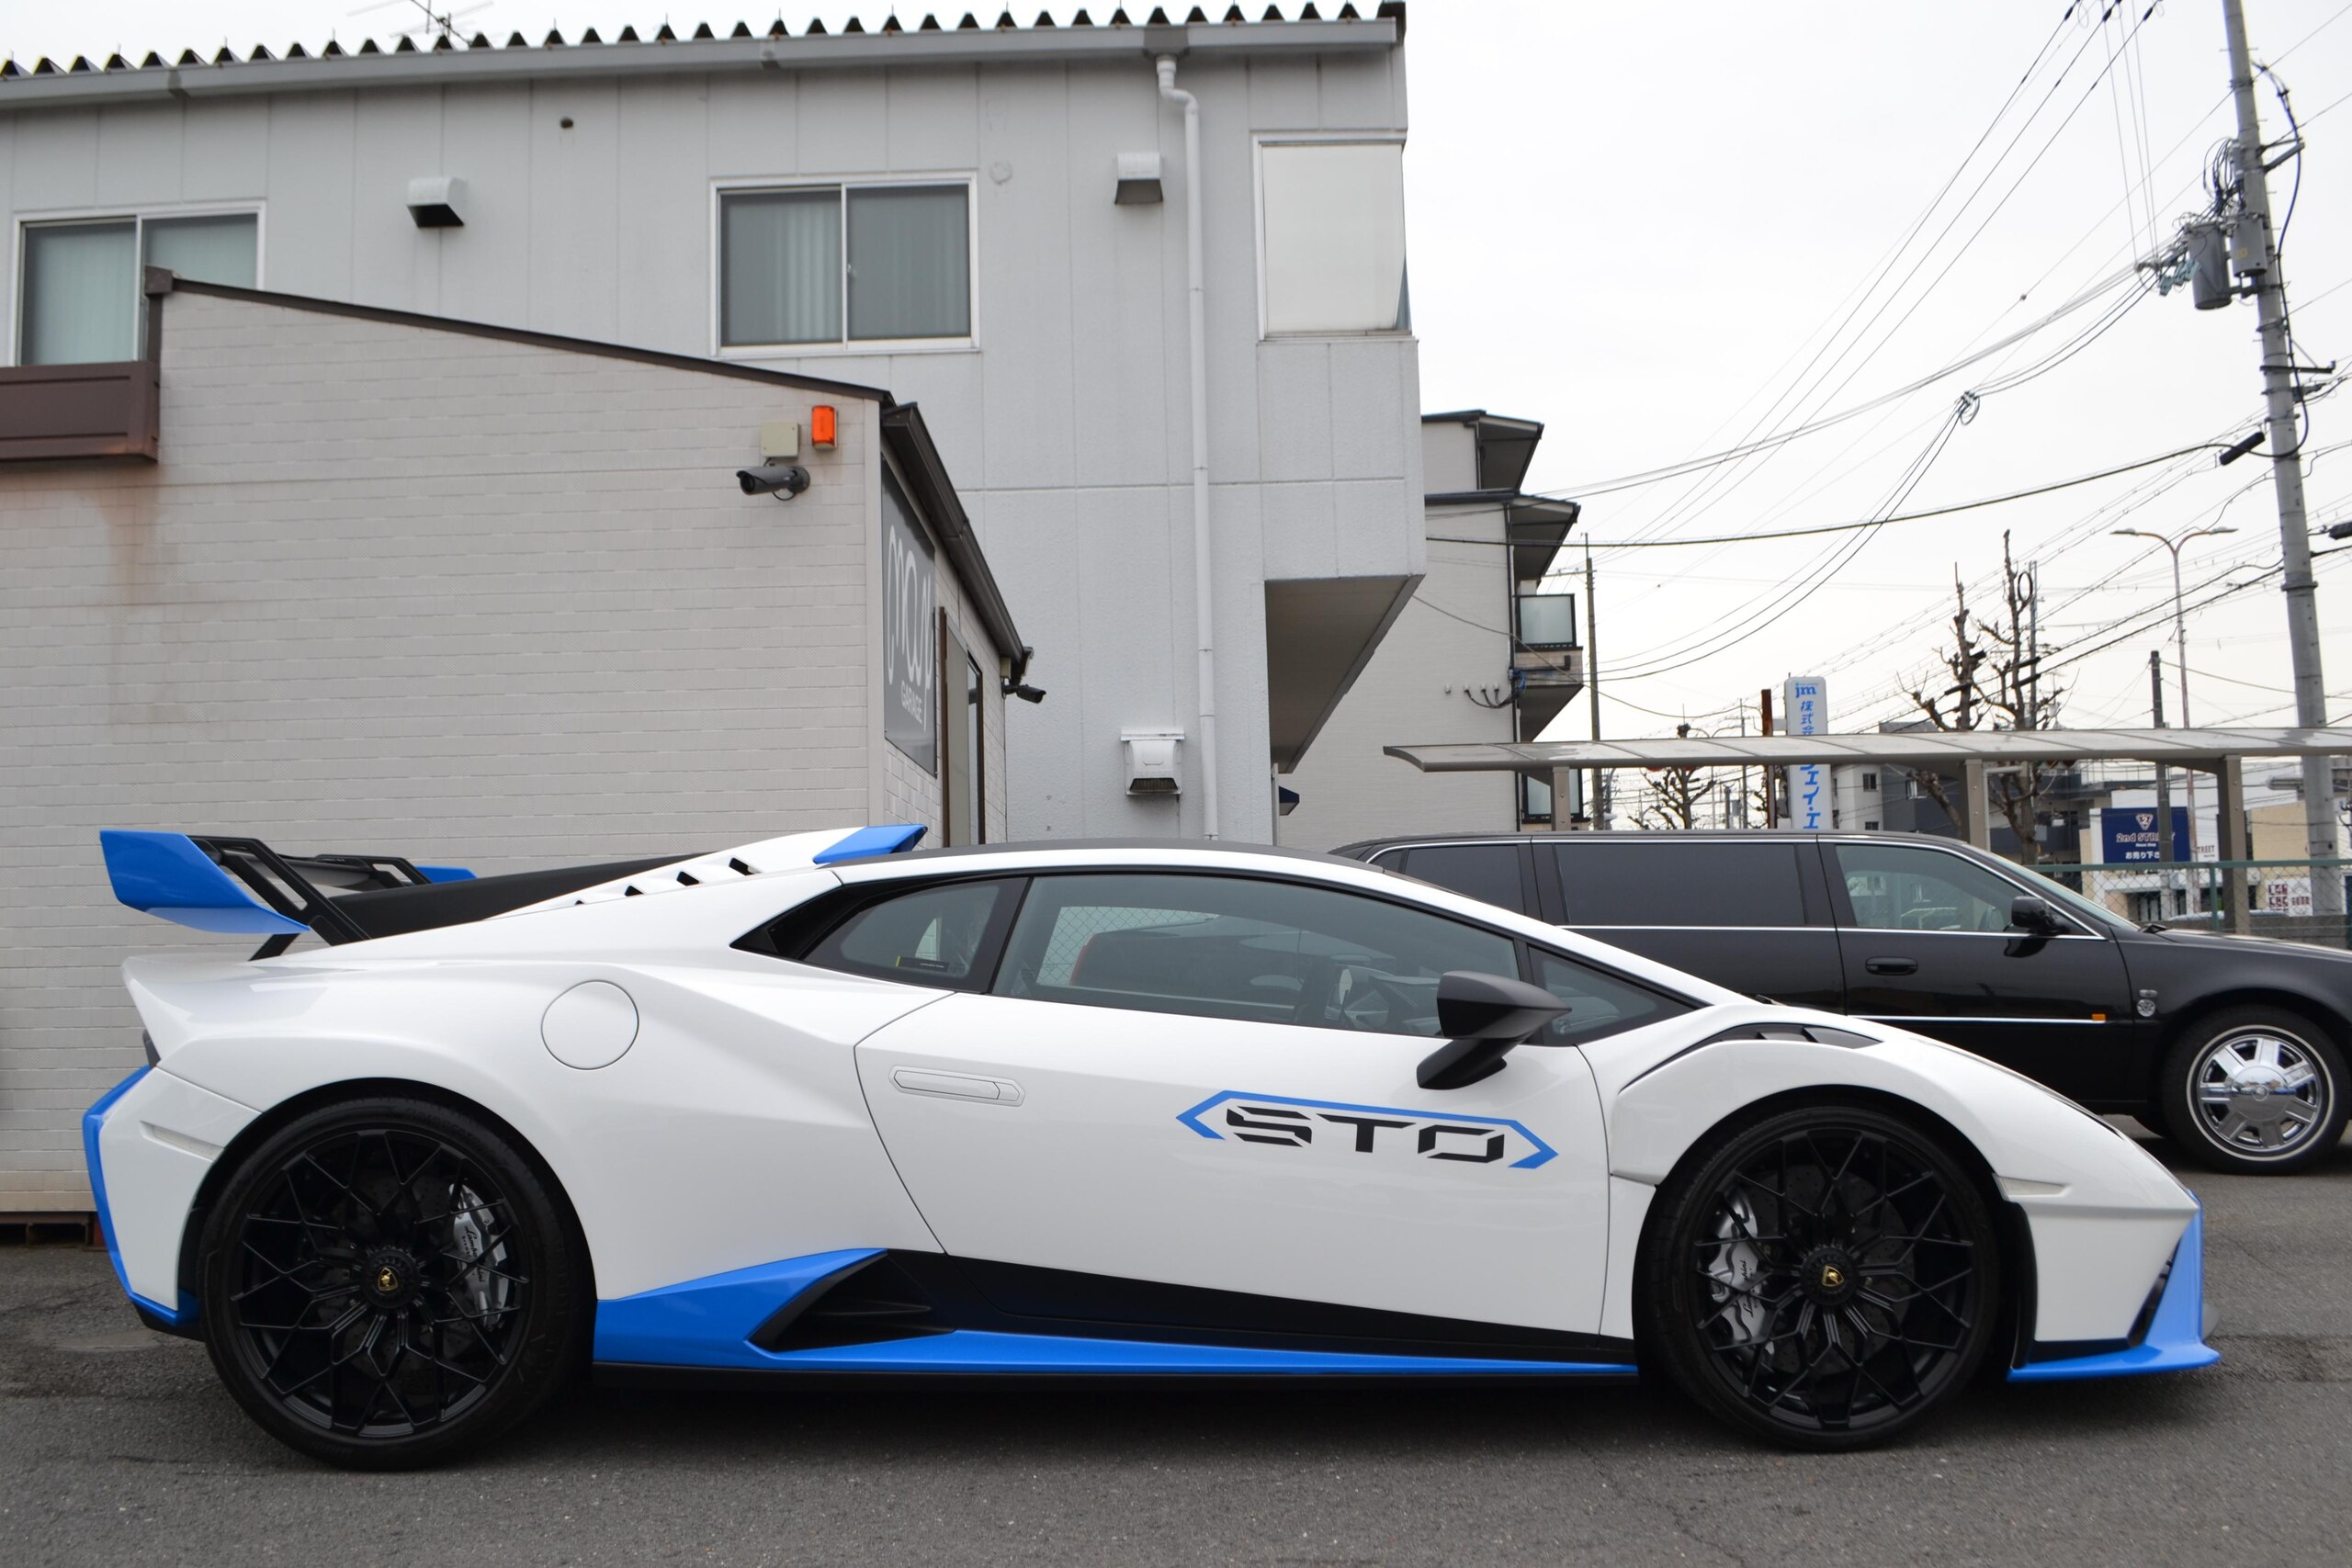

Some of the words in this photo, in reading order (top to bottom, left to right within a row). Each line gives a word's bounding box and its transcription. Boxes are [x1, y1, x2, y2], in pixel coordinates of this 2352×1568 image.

[901, 680, 922, 724] GARAGE
[2116, 832, 2136, 843] 2nd
[1226, 1106, 1505, 1164] STO
